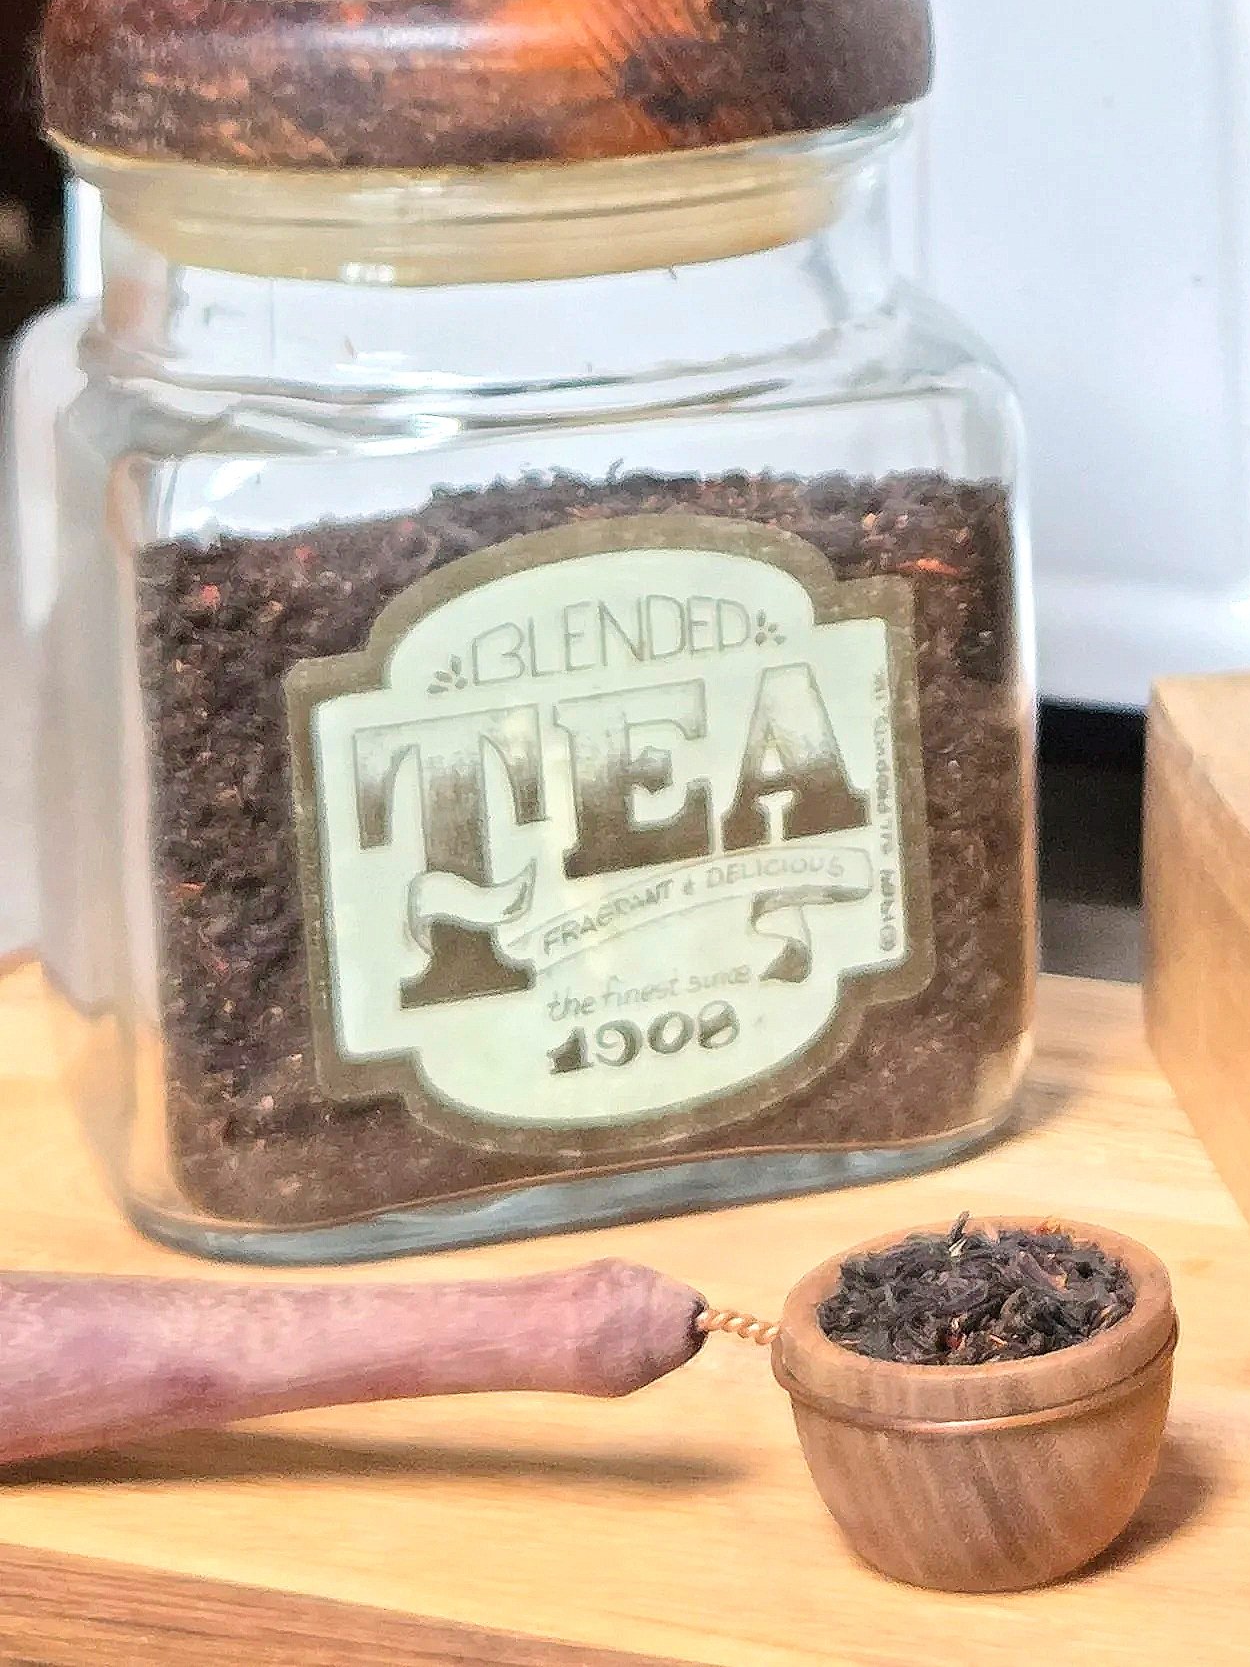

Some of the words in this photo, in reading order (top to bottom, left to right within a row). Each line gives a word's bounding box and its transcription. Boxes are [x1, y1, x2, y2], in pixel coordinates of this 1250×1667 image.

[473, 594, 752, 685] BLENDED
[353, 662, 872, 1011] TEA
[543, 877, 673, 955] FRAGRANT
[705, 855, 845, 890] DELICIOUS
[545, 986, 595, 1022] the
[602, 974, 679, 1009] finest
[545, 999, 741, 1074] 1908
